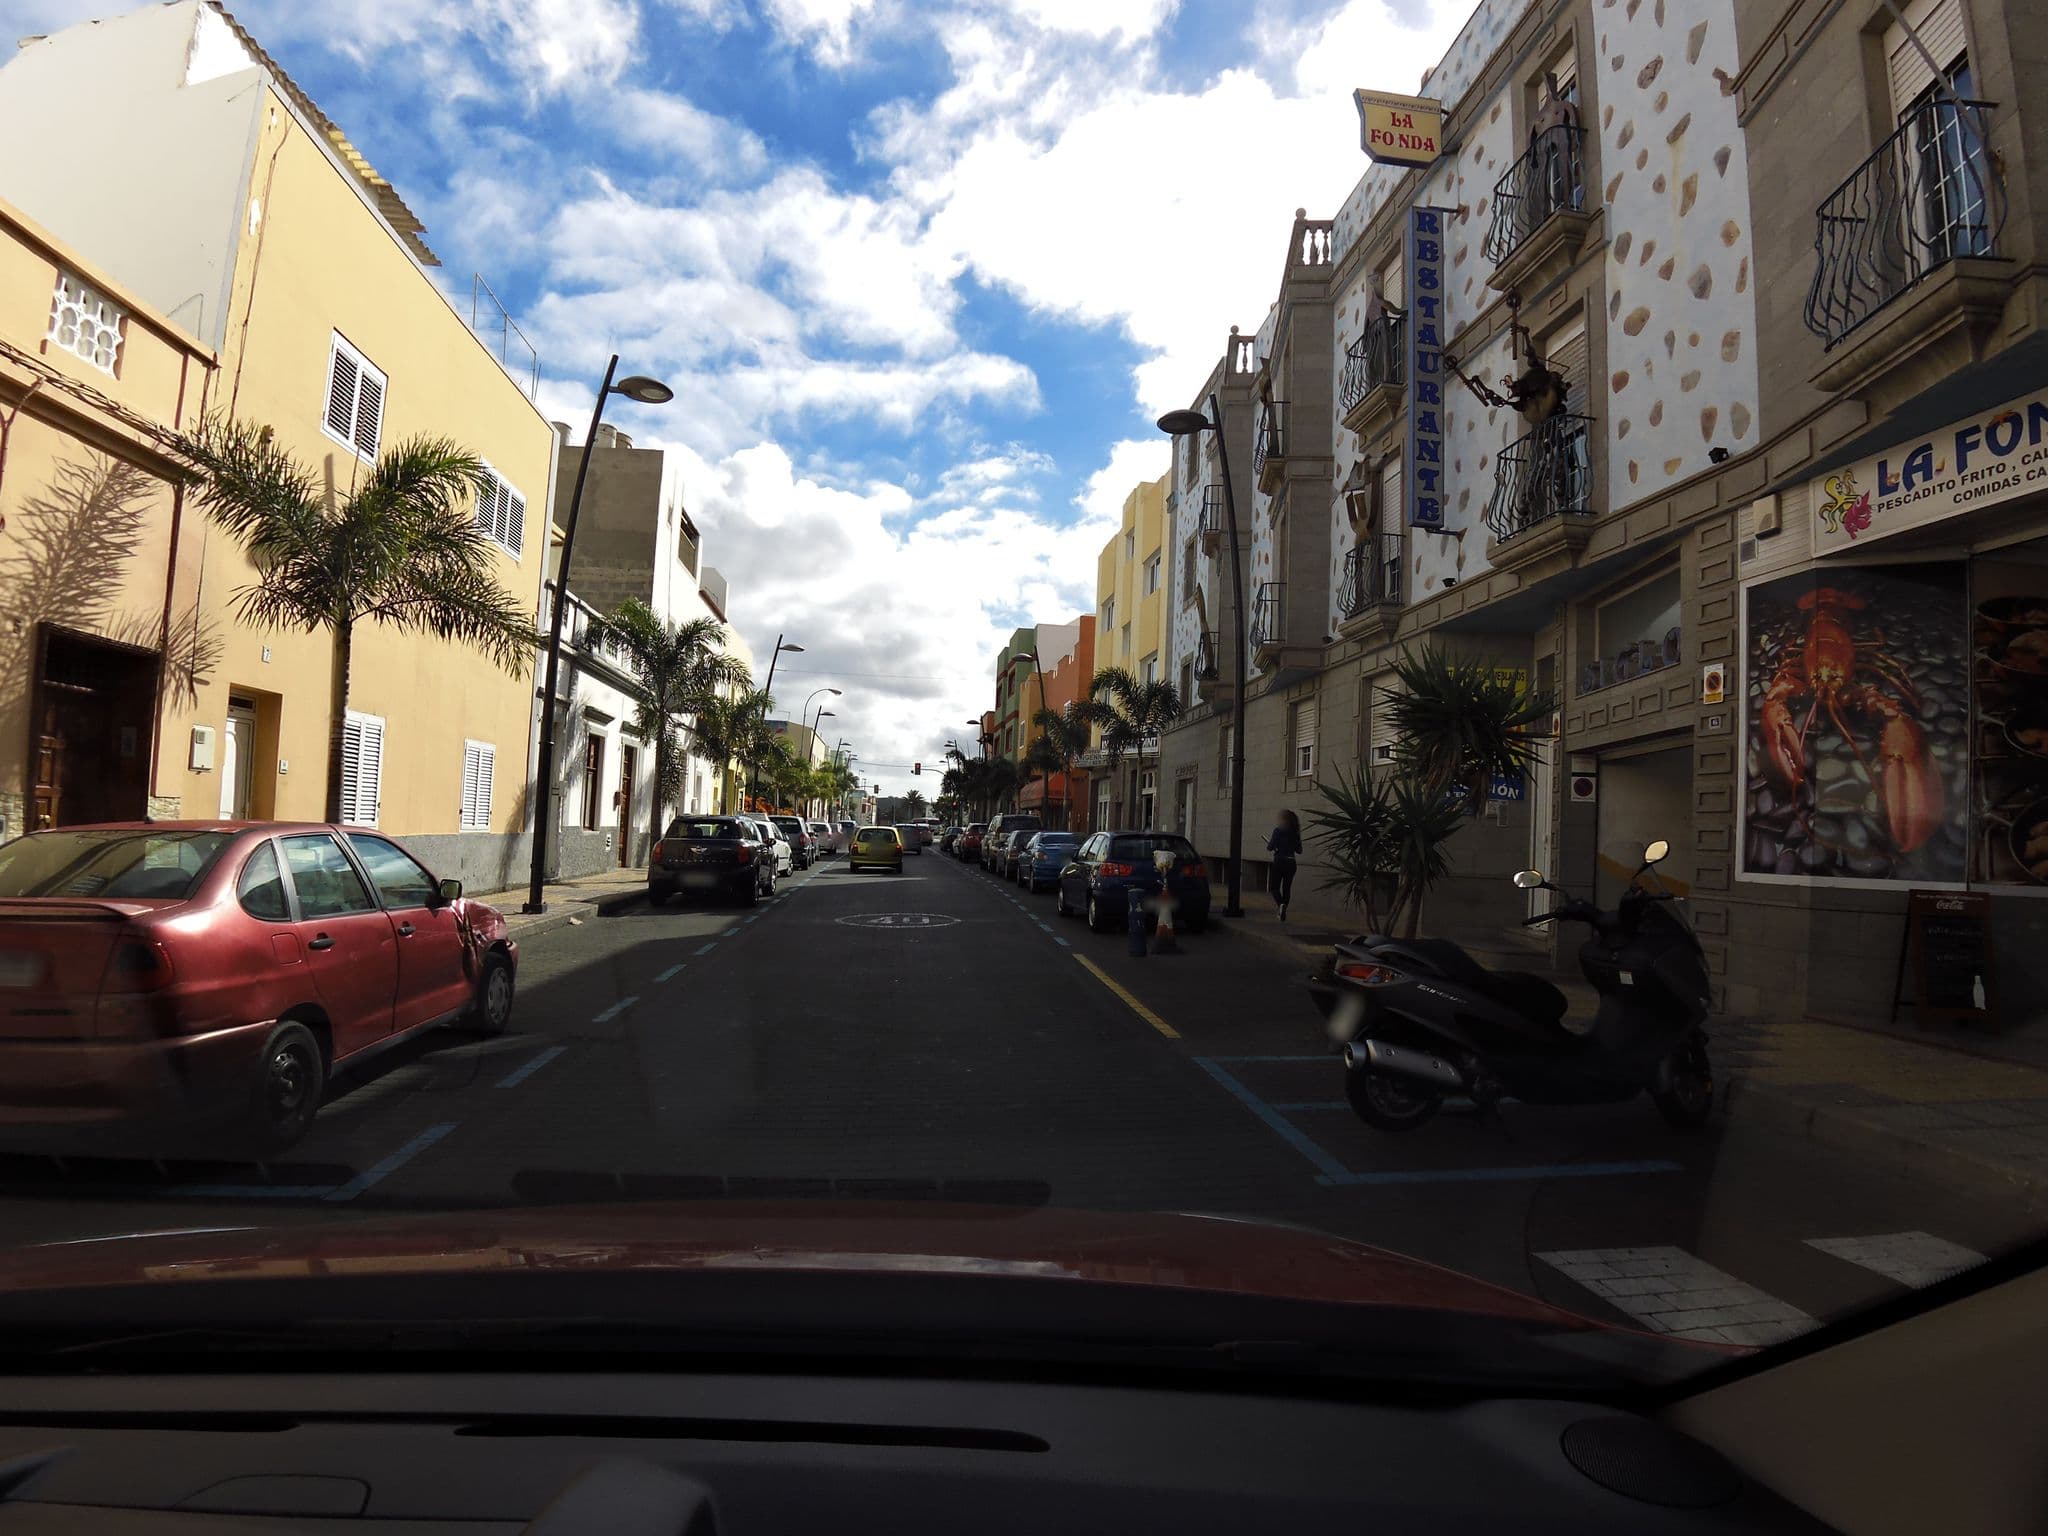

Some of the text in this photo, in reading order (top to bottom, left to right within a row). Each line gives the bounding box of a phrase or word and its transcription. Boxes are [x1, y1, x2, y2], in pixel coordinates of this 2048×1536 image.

[1391, 112, 1414, 129] LA
[1371, 129, 1435, 152] FONDA
[1416, 210, 1440, 522] RESTAURANTE
[1877, 442, 1934, 497] LA
[1877, 480, 1955, 512] PESCADITO
[1953, 474, 2021, 504] COMIDAS
